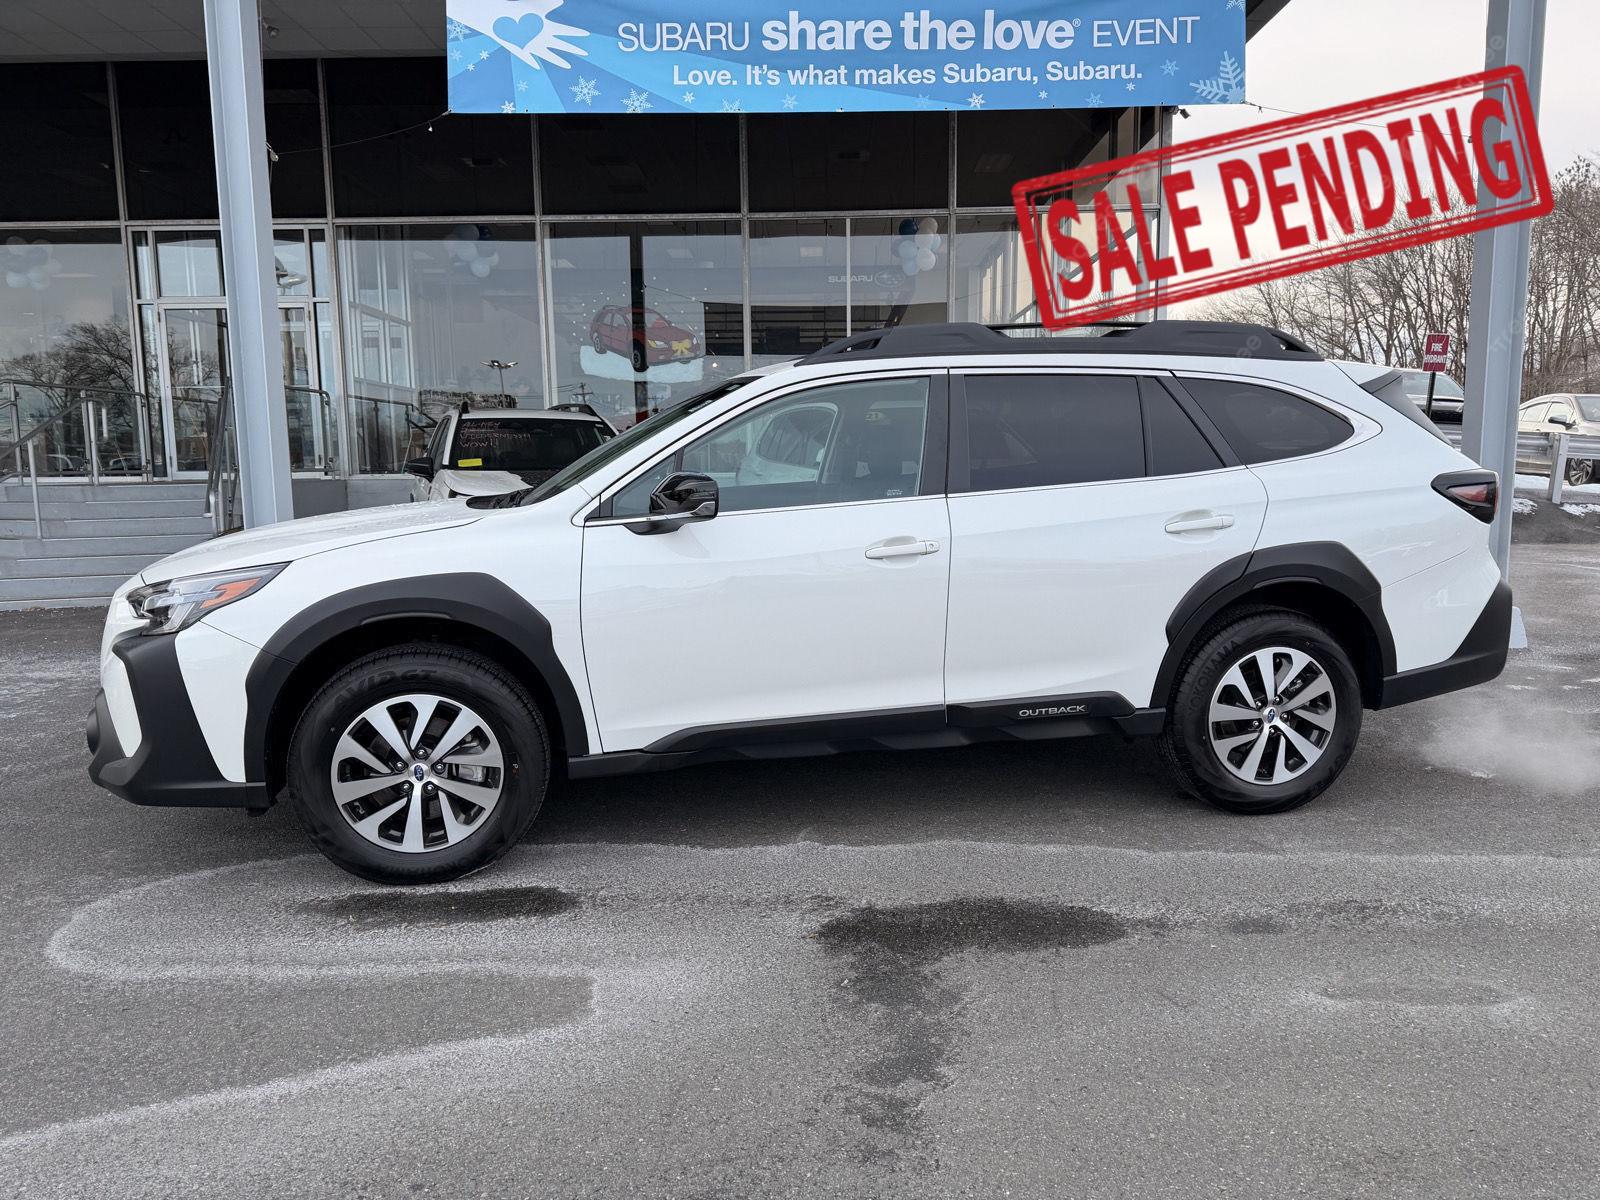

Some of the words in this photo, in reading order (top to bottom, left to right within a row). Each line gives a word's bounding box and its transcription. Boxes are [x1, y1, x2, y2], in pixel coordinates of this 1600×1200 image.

[618, 22, 749, 53] SUBARU
[761, 11, 892, 52] share
[900, 10, 976, 51] the
[1092, 16, 1200, 48] EVENT
[673, 64, 737, 86] Love.
[746, 64, 780, 86] It's
[787, 64, 847, 86] what
[855, 64, 936, 85] makes
[942, 63, 1038, 86] Subaru,
[1045, 60, 1142, 82] Subaru.
[1424, 354, 1447, 364] HYDRANT
[1018, 705, 1086, 717] OUTBACK
